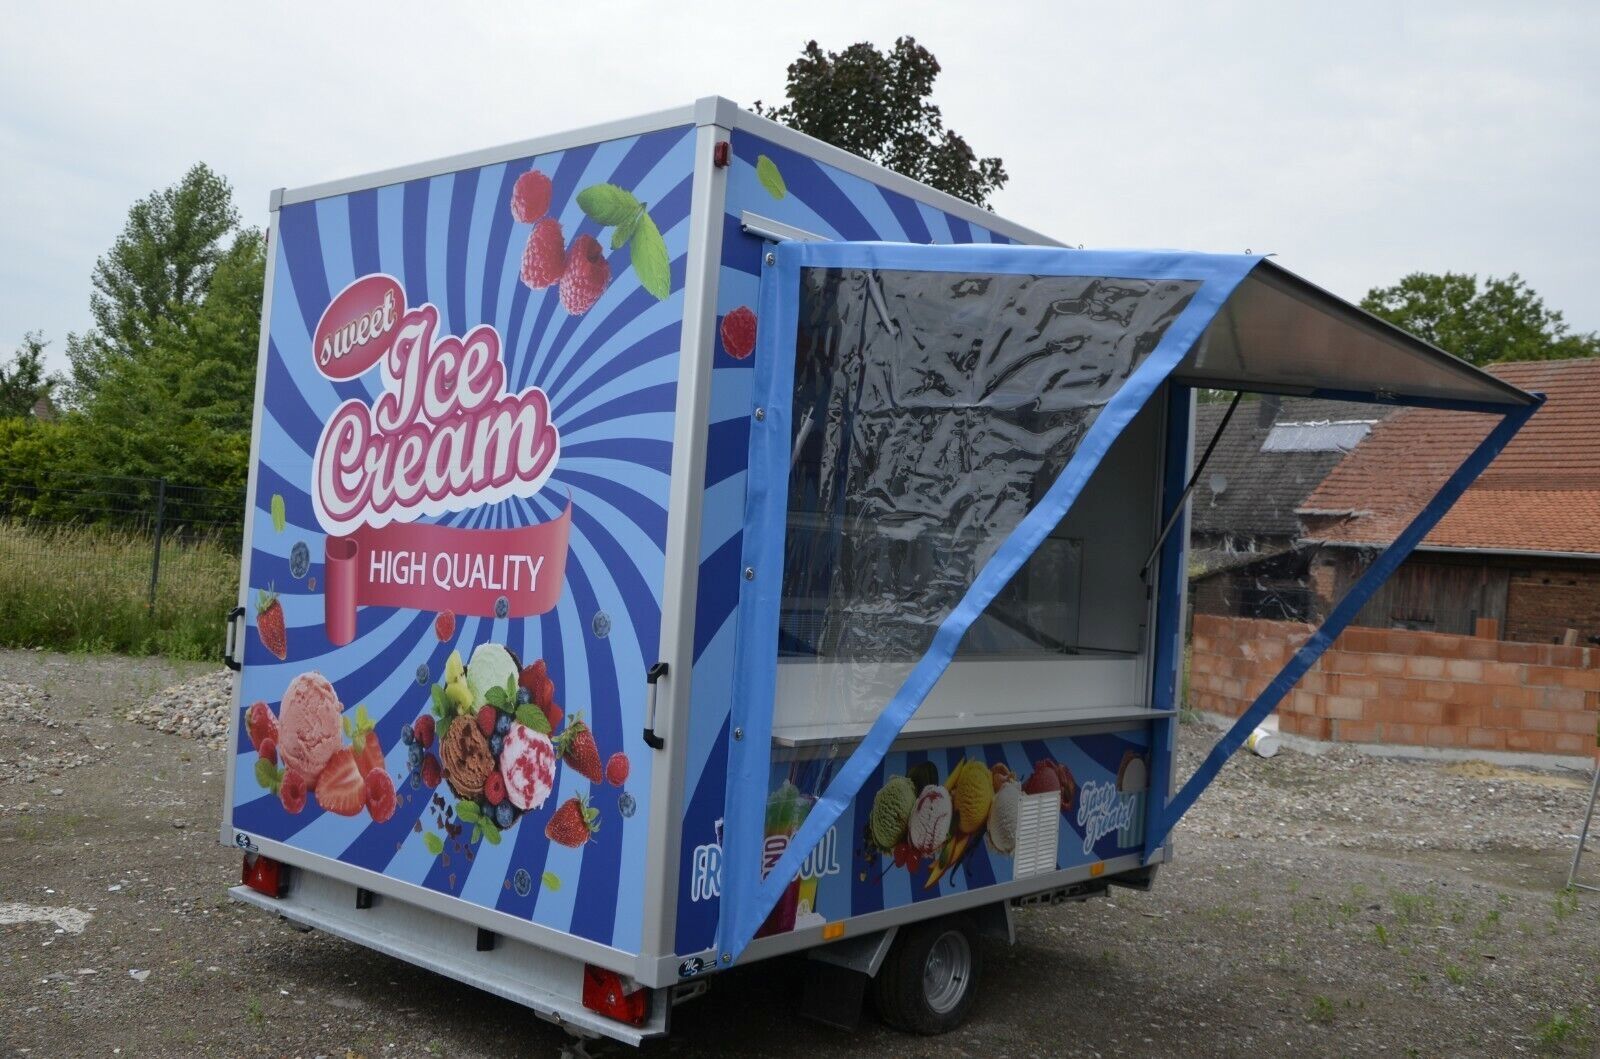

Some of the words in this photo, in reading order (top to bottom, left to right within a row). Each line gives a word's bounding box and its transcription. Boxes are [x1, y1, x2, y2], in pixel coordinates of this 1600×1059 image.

[319, 288, 397, 367] sweet
[375, 314, 498, 433] Ice
[319, 399, 551, 518] Cream
[369, 550, 426, 585] HIGH
[432, 552, 544, 592] QUALITY
[691, 843, 722, 902] FR
